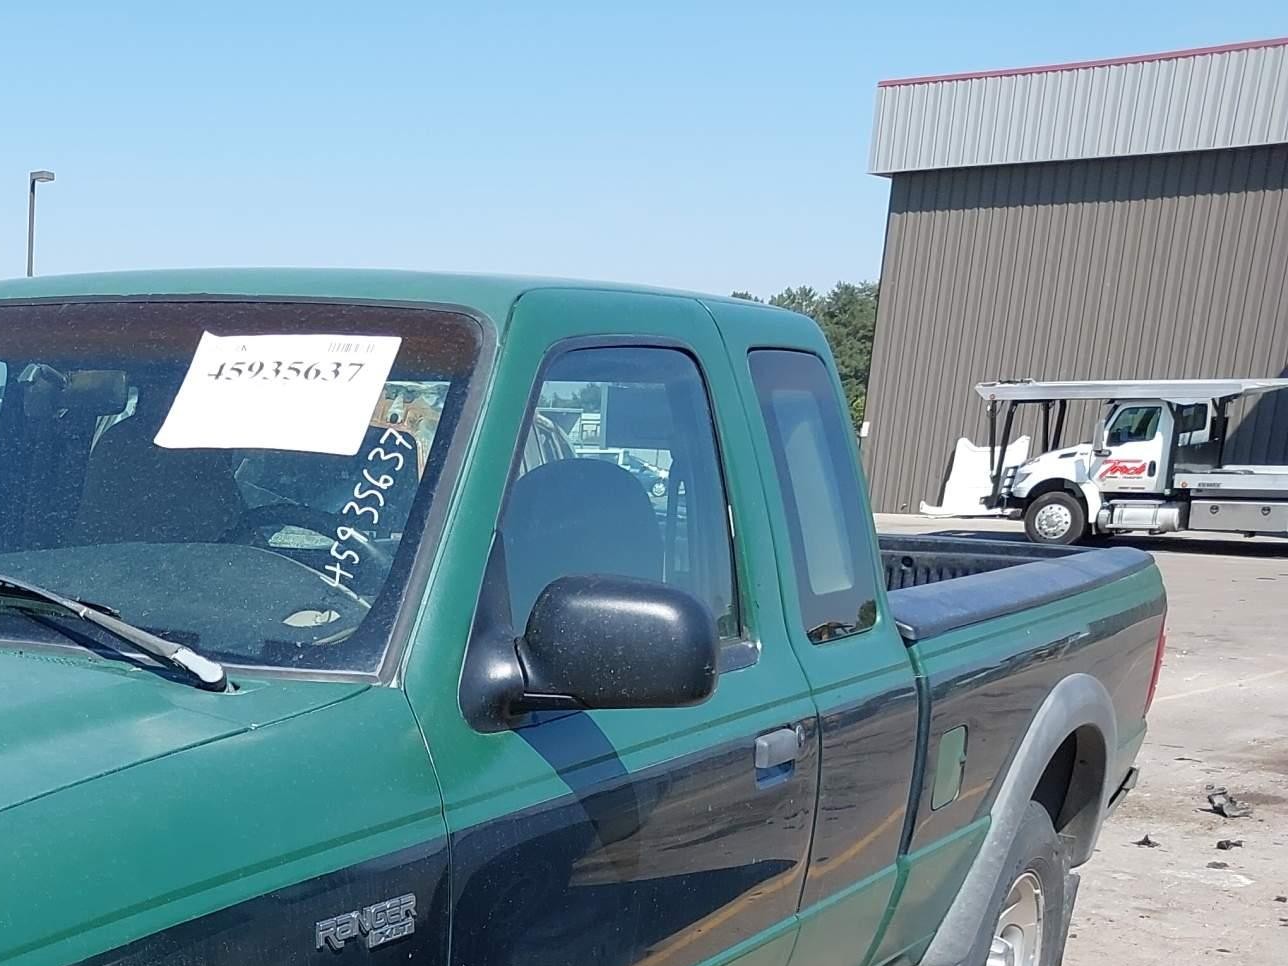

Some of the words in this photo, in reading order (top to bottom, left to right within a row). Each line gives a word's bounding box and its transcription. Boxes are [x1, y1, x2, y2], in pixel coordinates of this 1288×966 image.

[208, 360, 364, 381] 45935637
[320, 427, 412, 587] 45935637
[315, 892, 418, 950] RANGER
